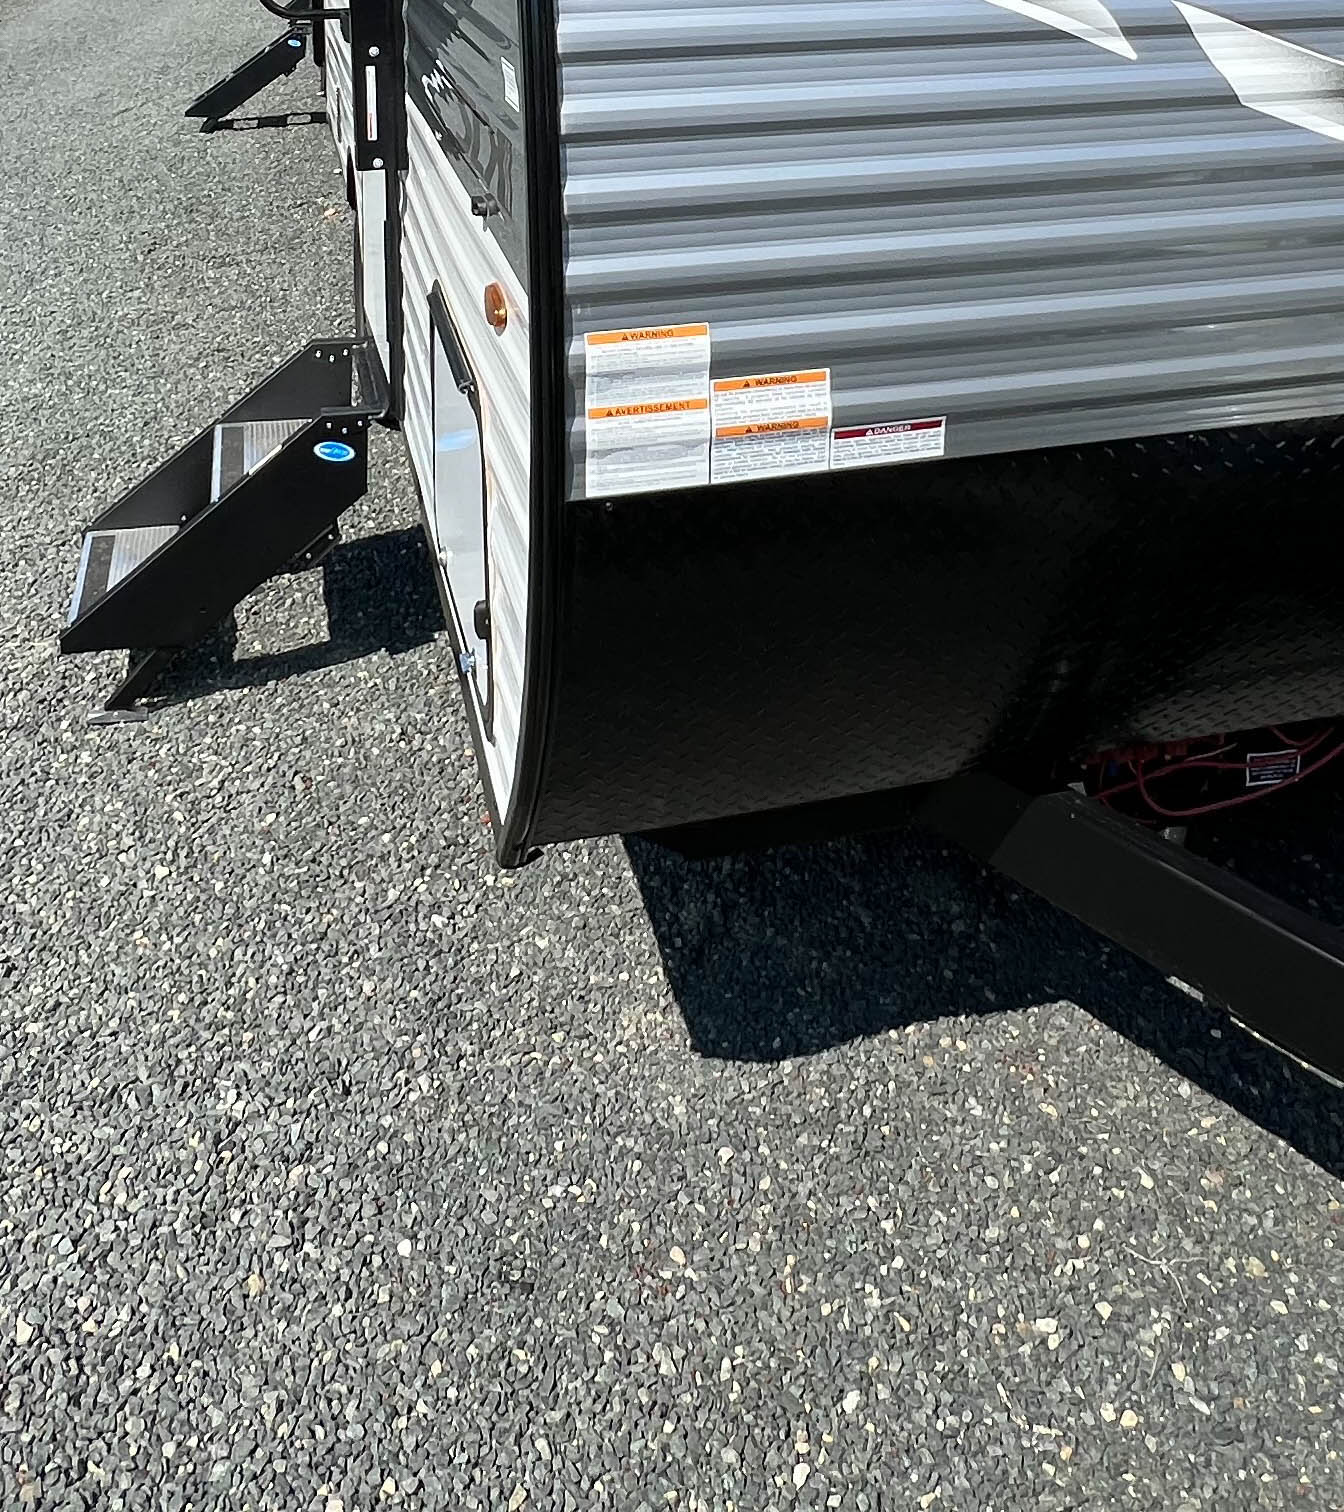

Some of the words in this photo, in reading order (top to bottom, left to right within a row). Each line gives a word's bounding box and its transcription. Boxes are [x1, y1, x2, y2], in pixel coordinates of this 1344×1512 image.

[630, 329, 674, 341] WARNING
[756, 375, 798, 386] WARNING
[616, 401, 691, 417] AVERTISSEMENT
[873, 424, 911, 435] DANGER
